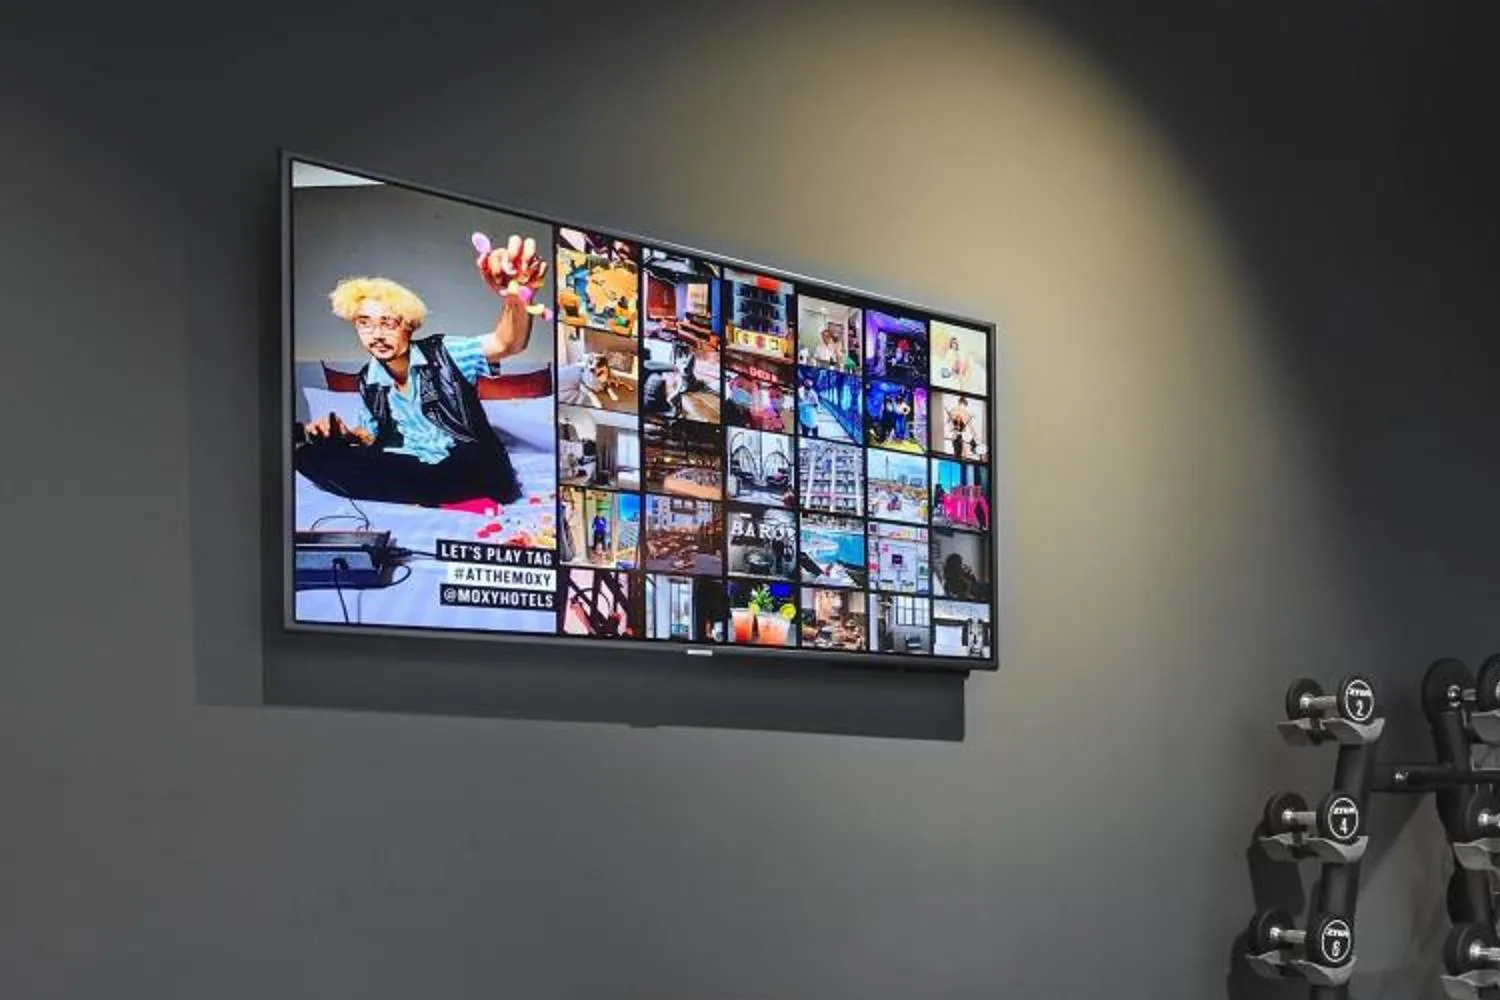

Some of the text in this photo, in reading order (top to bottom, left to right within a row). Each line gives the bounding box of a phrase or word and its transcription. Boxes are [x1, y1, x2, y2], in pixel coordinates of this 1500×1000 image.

[441, 543, 553, 566] LET'S PLAY TAG
[453, 566, 552, 587] #ATTHEMOXY
[443, 587, 554, 608] @MOXYHOTELS
[1356, 699, 1364, 717] 2
[1340, 816, 1349, 835] 4
[1331, 939, 1341, 958] 6
